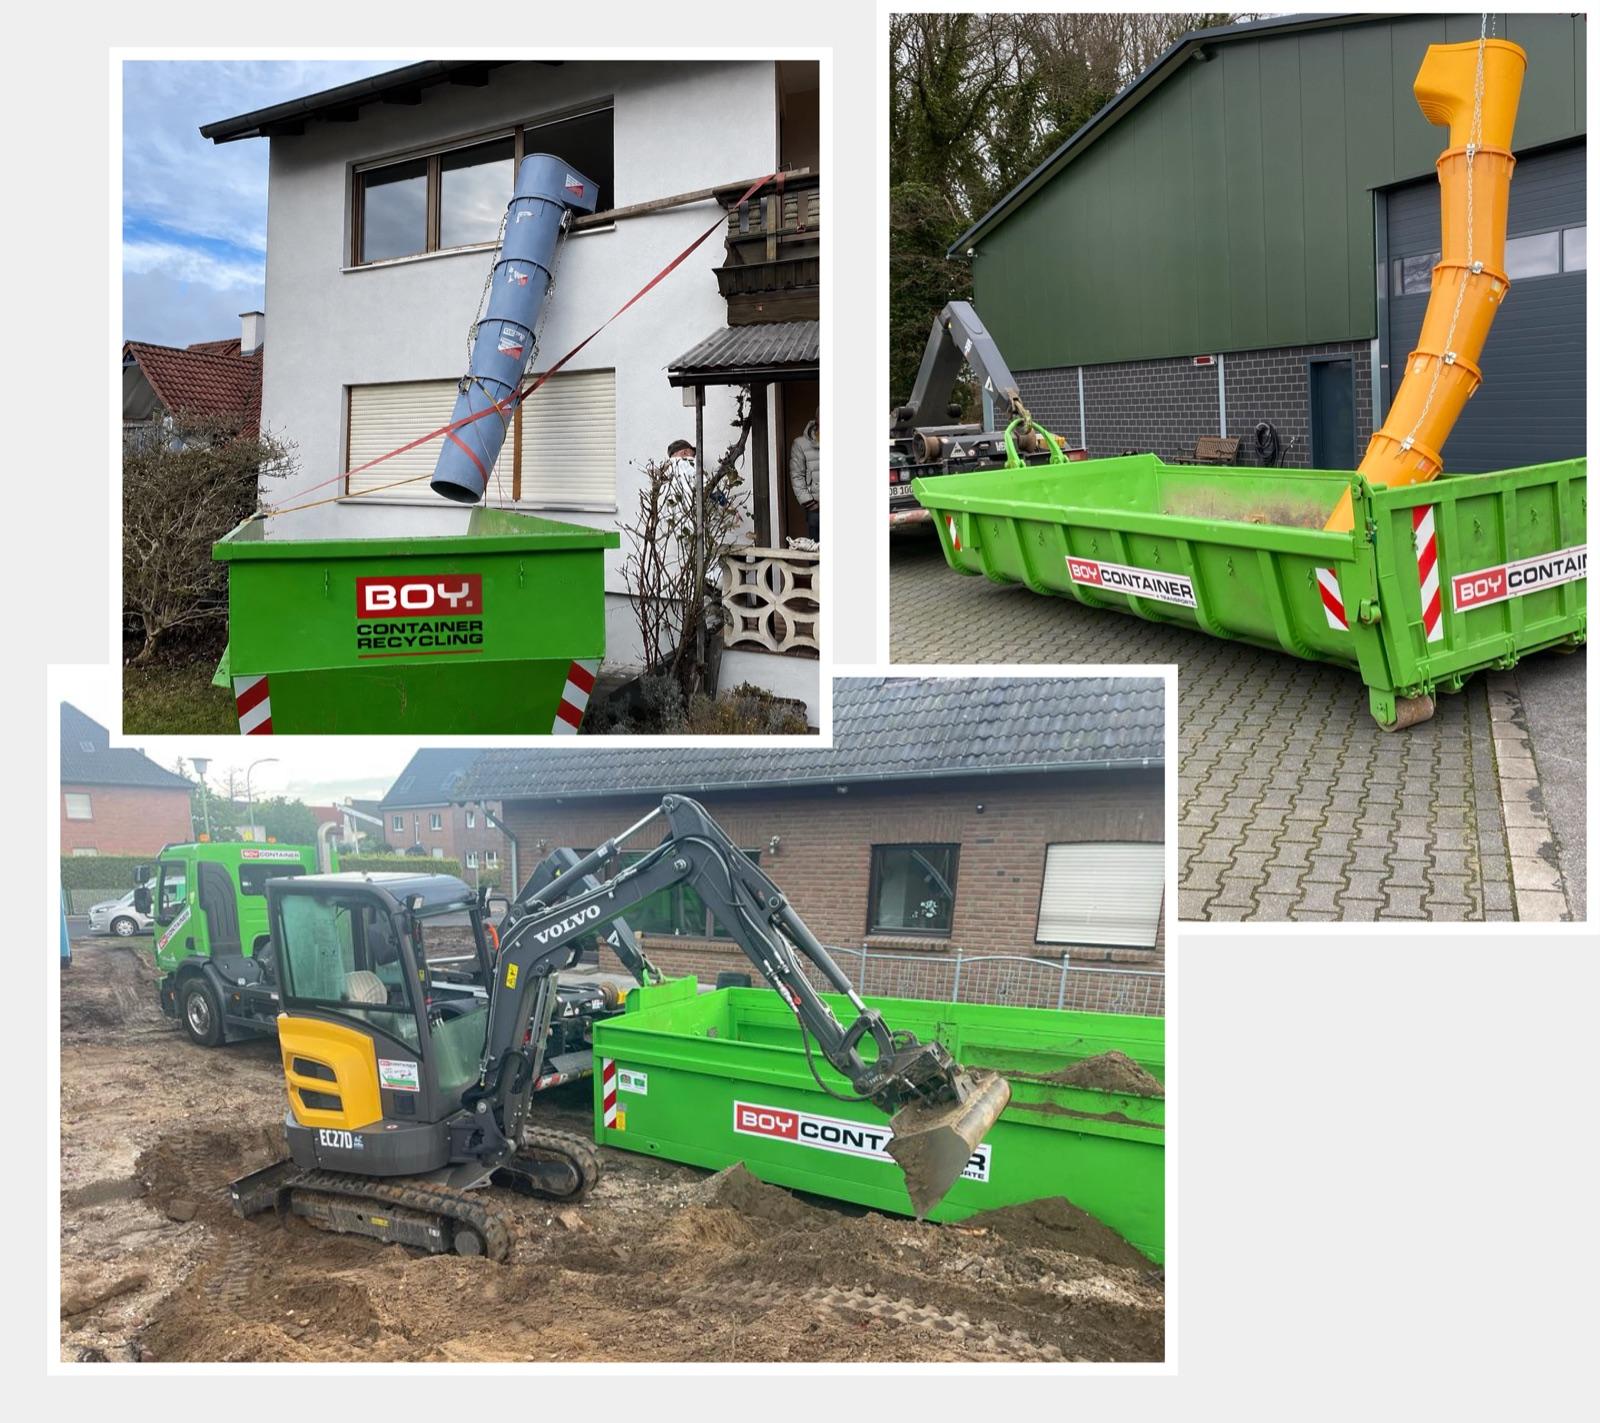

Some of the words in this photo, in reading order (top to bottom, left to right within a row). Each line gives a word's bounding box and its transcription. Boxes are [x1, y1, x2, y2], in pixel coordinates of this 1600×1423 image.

[1071, 564, 1098, 580] BOY
[1100, 569, 1193, 599] CONTAINER
[1461, 574, 1502, 602] BOY
[357, 620, 483, 636] CONTAINER
[357, 633, 483, 650] RECYCLING
[534, 905, 601, 945] VOLVO
[742, 1111, 793, 1133] BOY
[319, 1129, 353, 1149] EC27D
